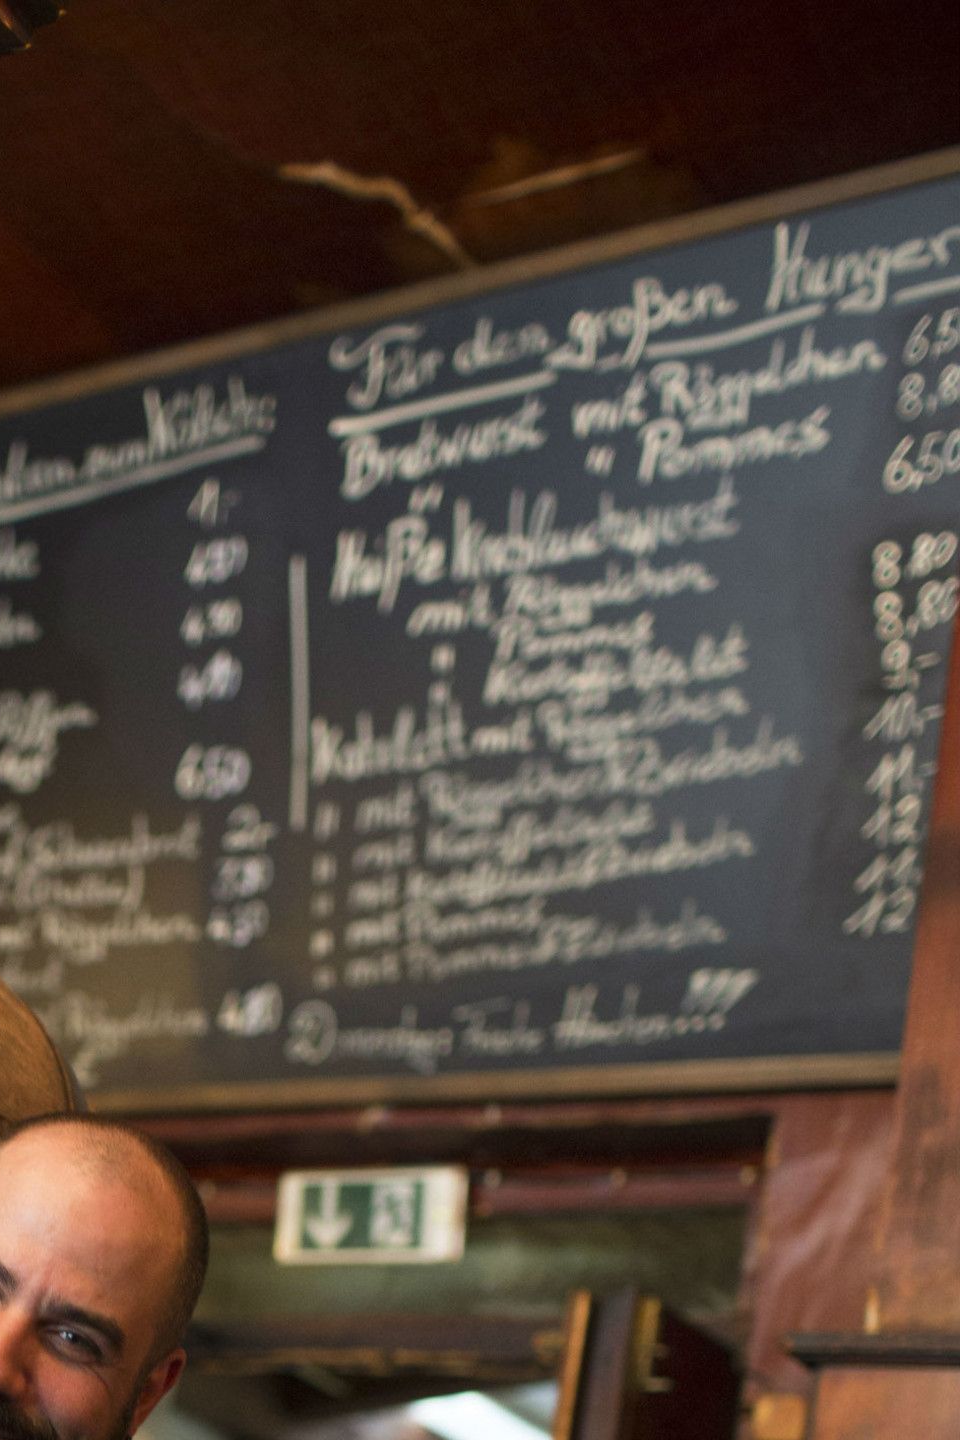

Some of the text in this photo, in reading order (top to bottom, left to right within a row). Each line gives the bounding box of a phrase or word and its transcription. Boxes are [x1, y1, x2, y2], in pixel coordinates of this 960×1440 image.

[331, 223, 960, 408] Für den großen Hunger
[341, 396, 546, 500] Bratwurst
[573, 375, 644, 436] mit
[640, 406, 830, 484] Pommes
